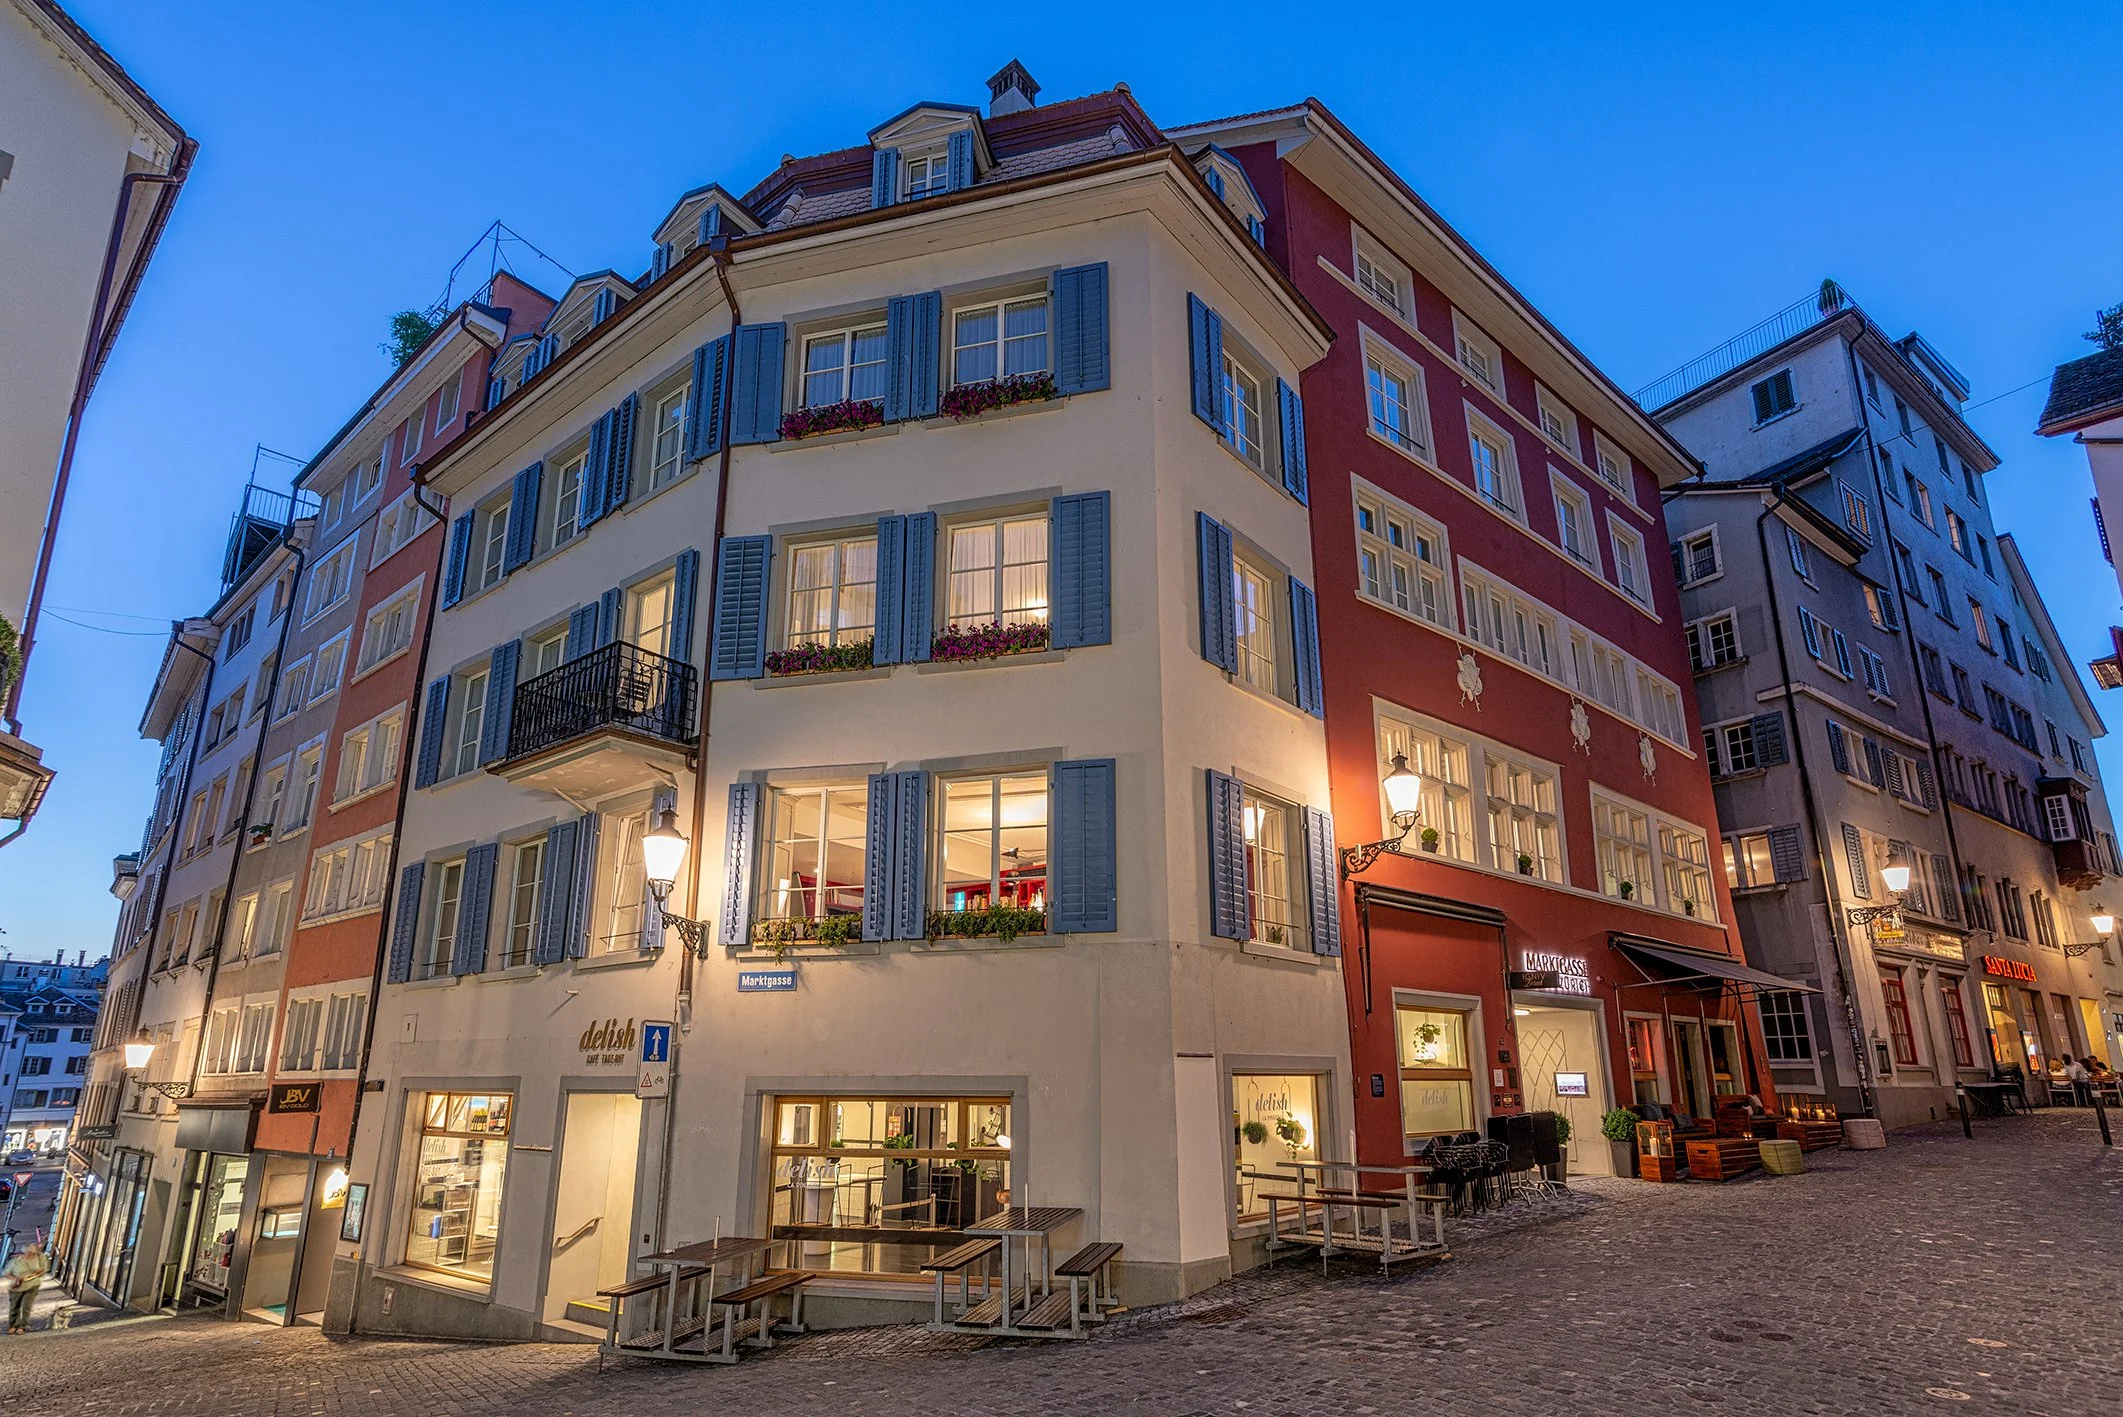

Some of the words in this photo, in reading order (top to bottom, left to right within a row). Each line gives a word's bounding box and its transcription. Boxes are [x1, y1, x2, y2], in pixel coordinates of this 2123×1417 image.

[1525, 953, 1588, 977] MARKTGASSE
[1985, 955, 2013, 977] SANTA
[2011, 960, 2037, 982] LUCIA
[741, 975, 792, 988] Marktgasse
[579, 1017, 636, 1051] delish
[280, 1089, 310, 1103] JBV
[1255, 1092, 1287, 1111] delish
[1421, 1089, 1448, 1105] delish
[777, 1158, 836, 1178] delish
